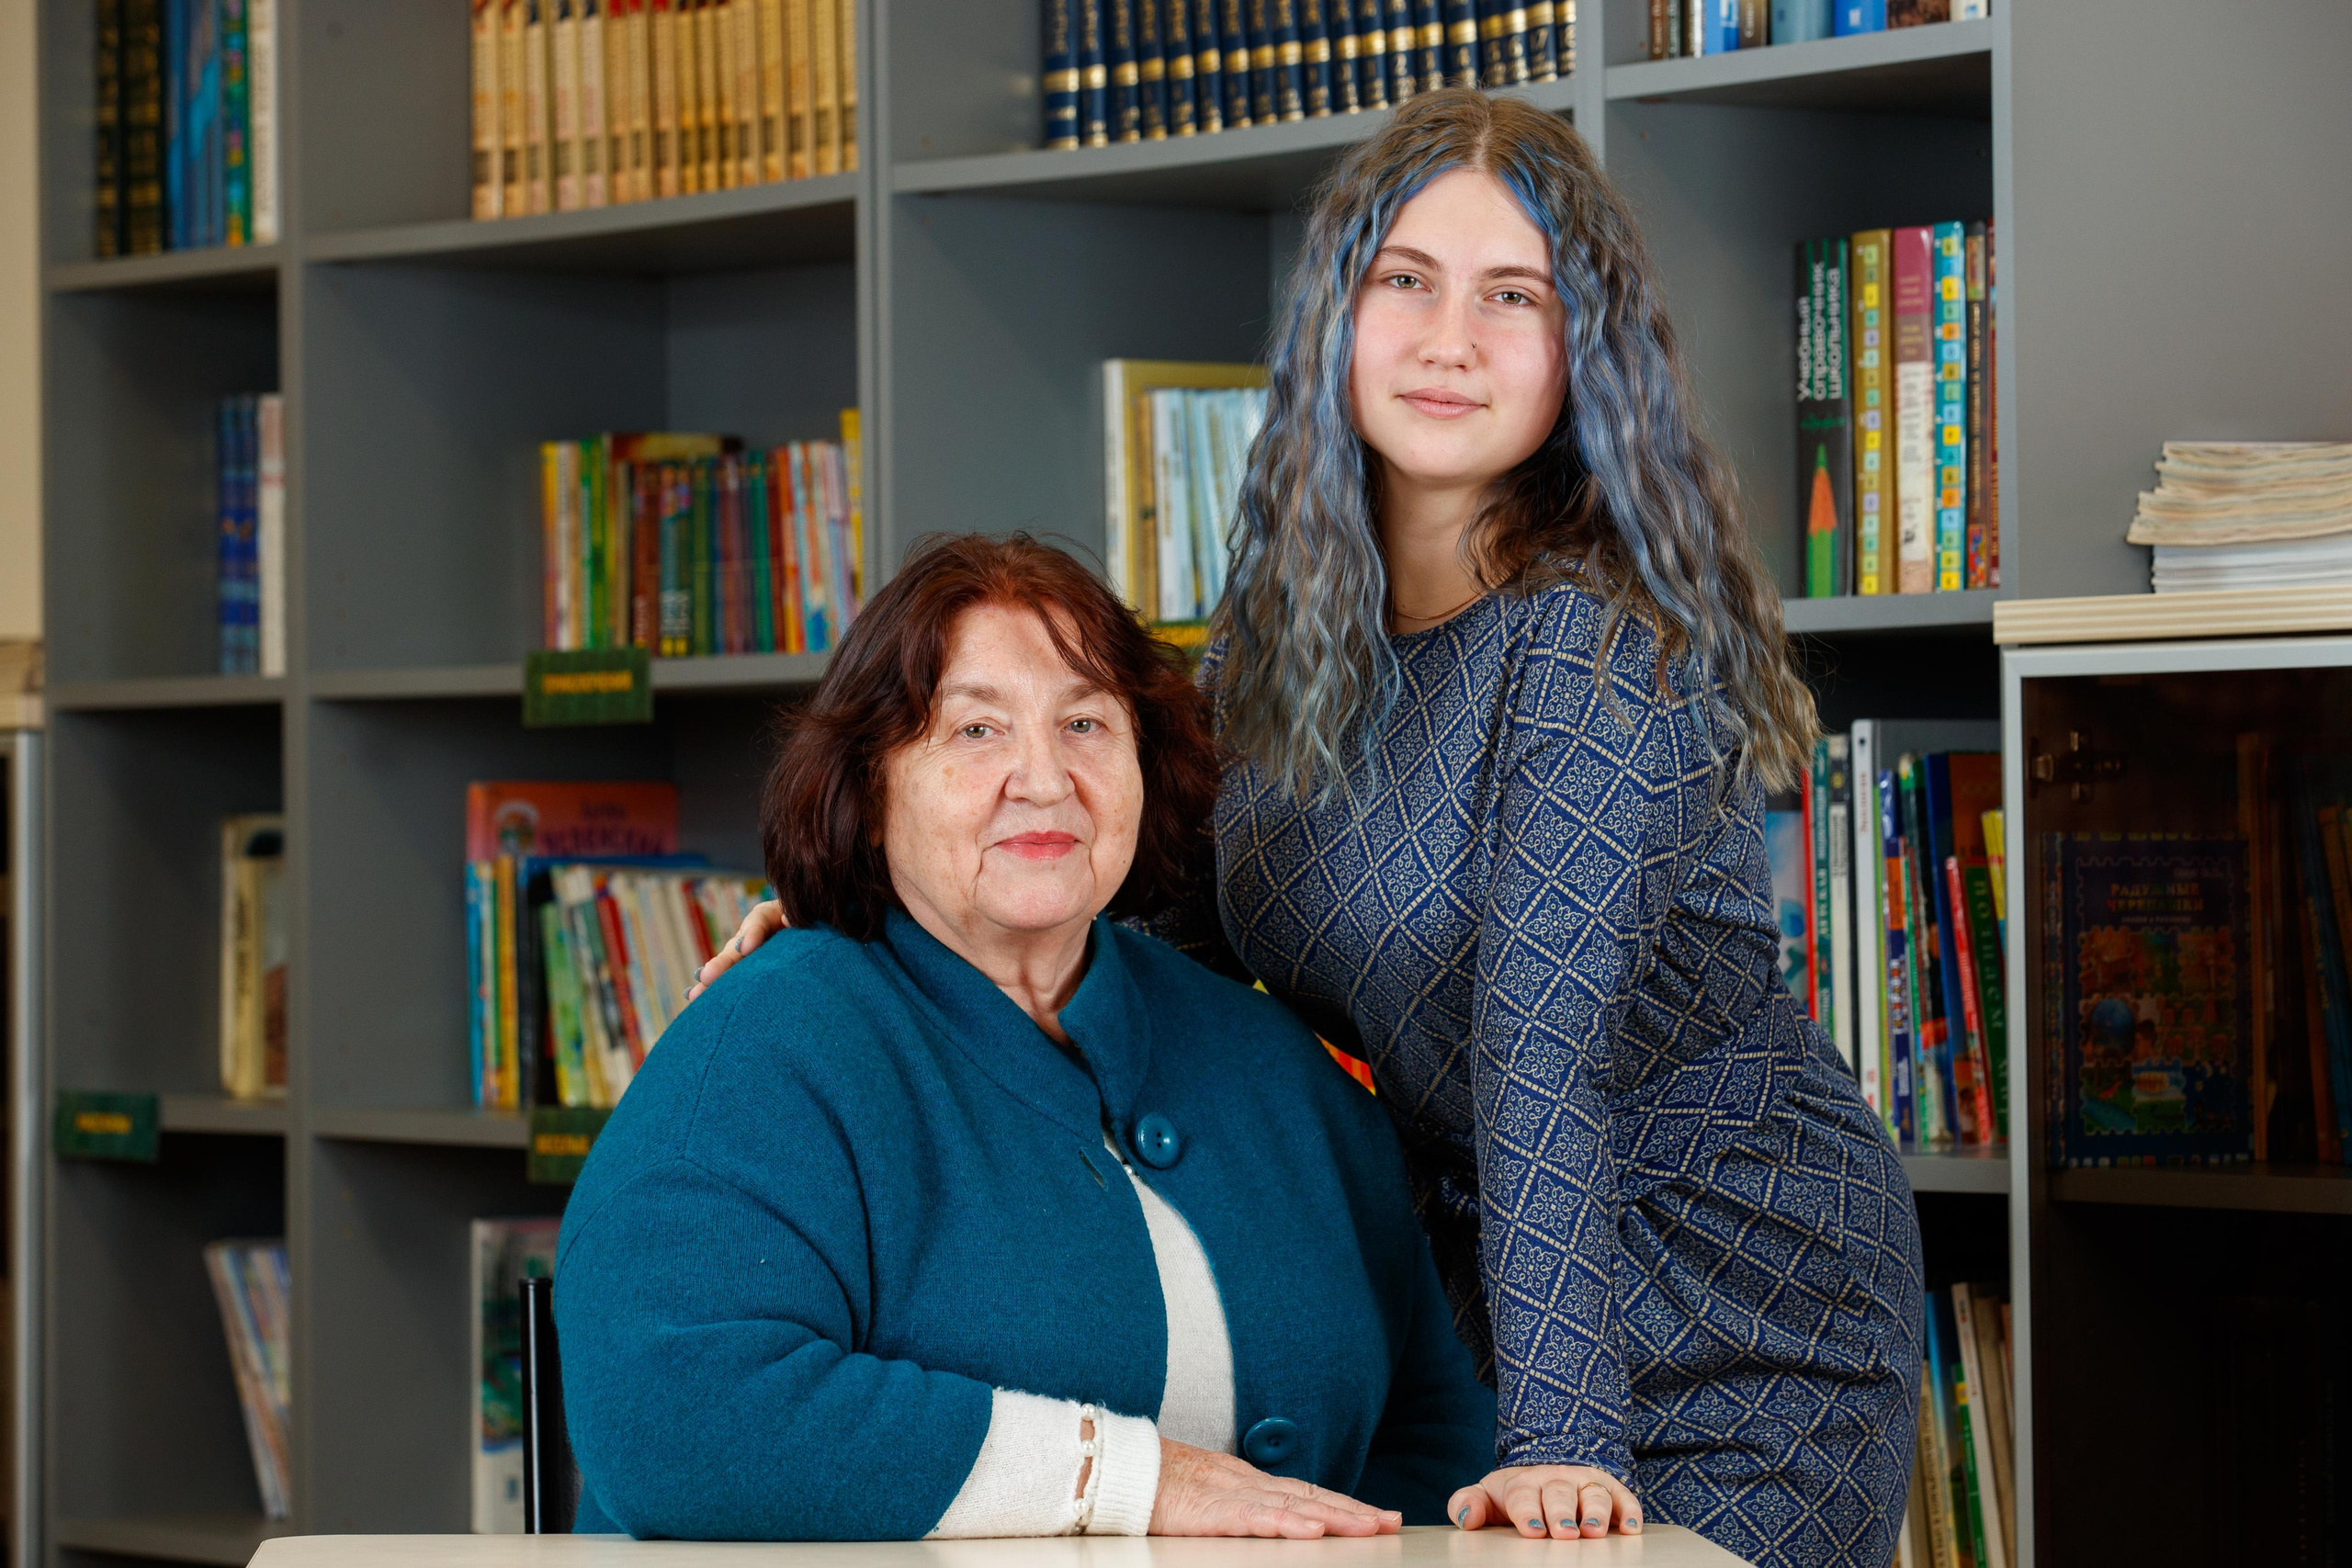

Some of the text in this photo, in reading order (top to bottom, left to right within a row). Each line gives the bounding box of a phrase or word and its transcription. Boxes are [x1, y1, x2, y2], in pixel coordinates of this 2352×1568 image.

[1797, 296, 1812, 401] Учебный
[1812, 261, 1829, 400] справочник
[1826, 268, 1842, 400] школьника
